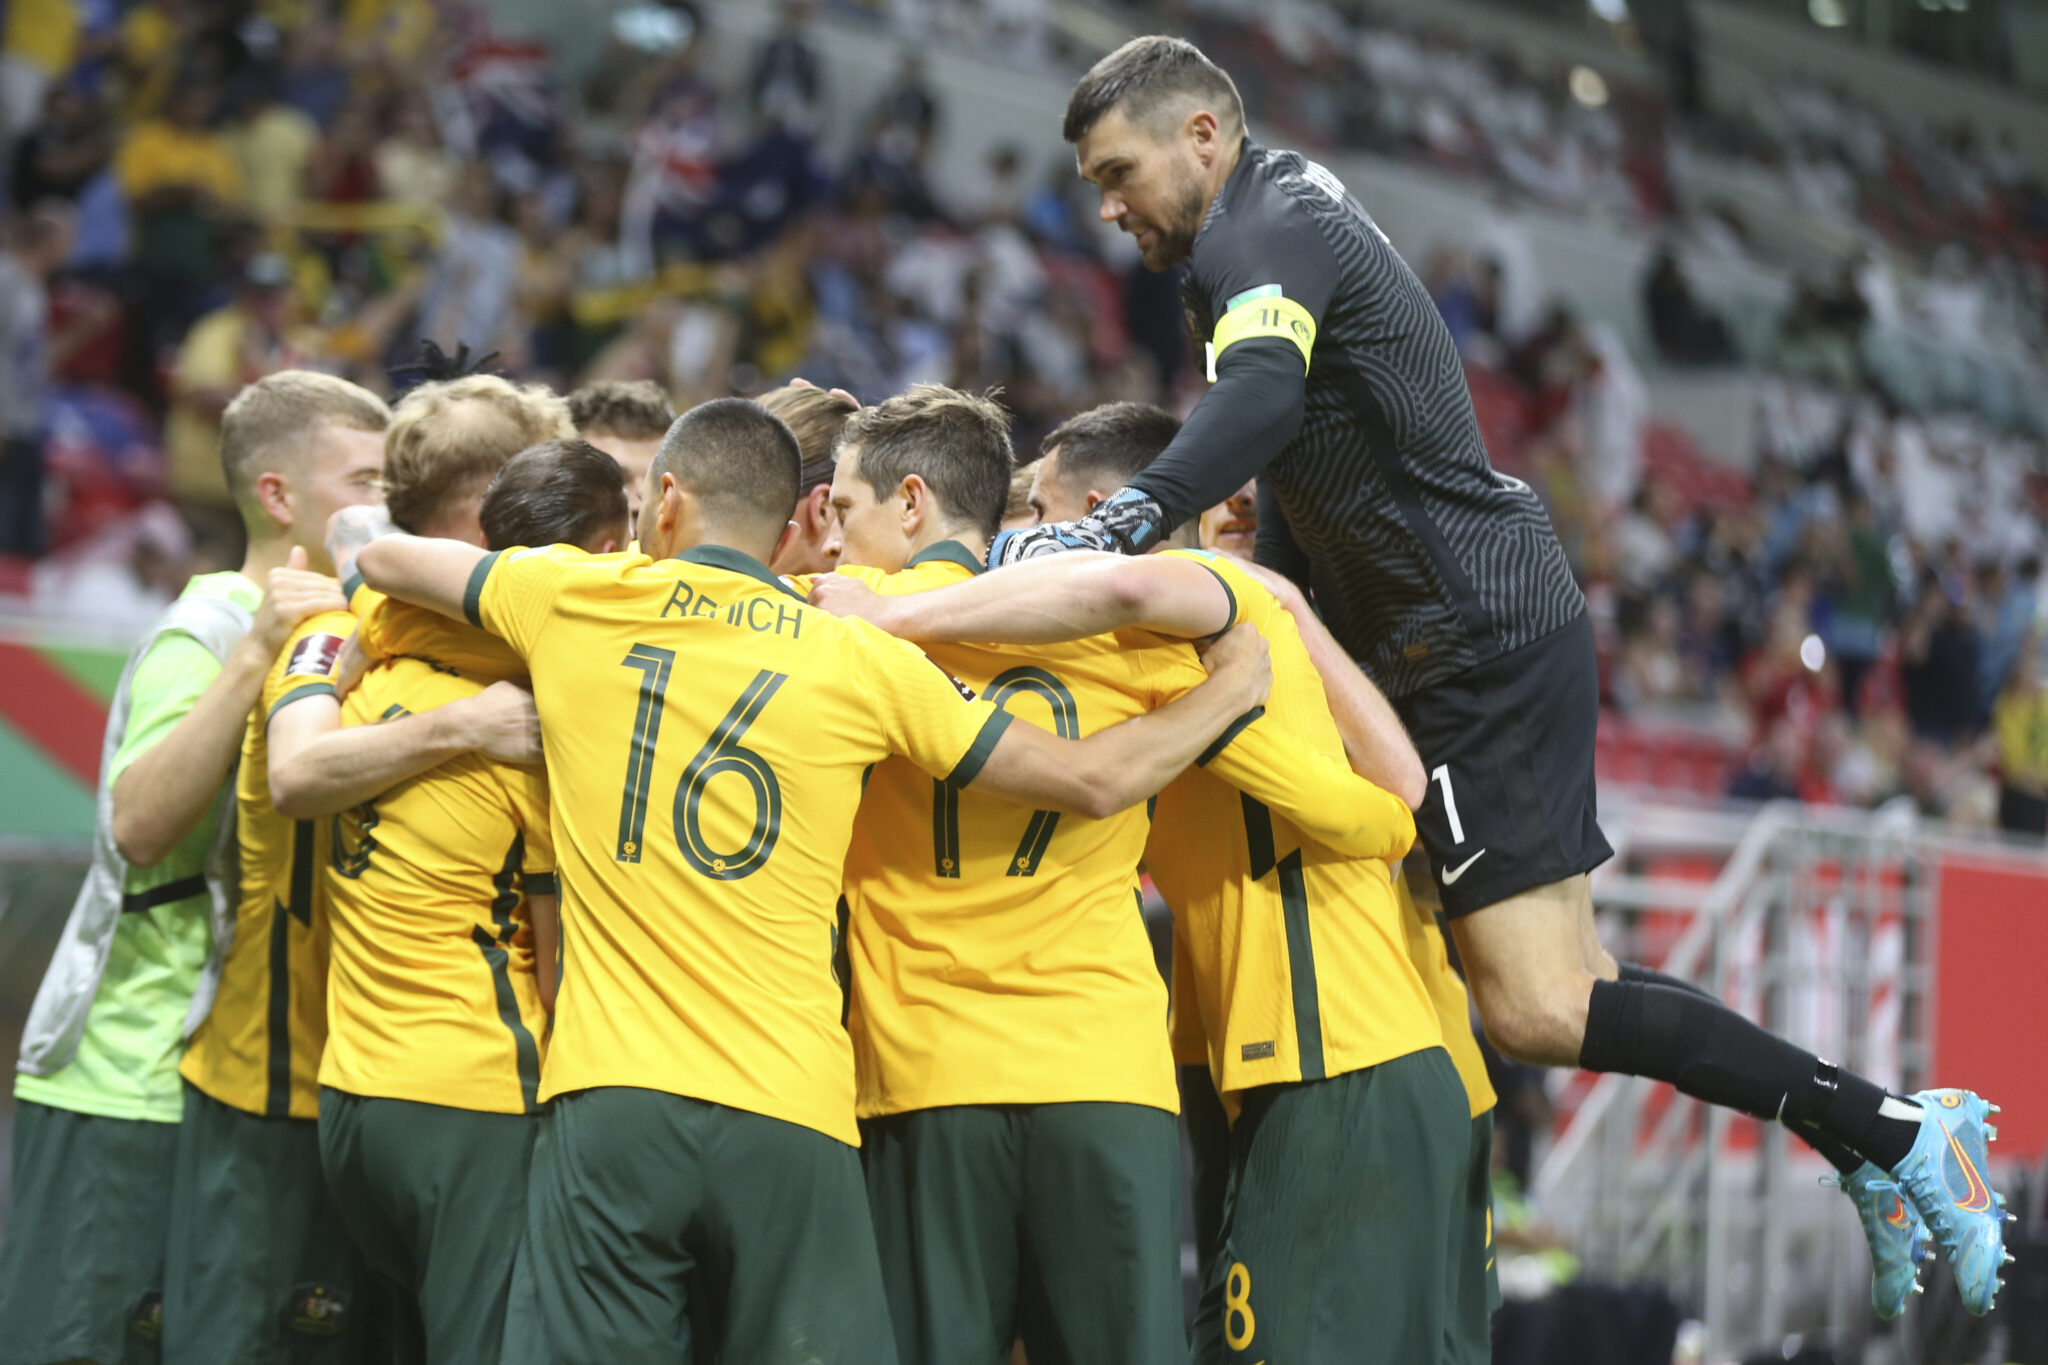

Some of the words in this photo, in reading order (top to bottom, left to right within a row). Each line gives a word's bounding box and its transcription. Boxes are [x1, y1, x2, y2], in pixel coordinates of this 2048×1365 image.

[615, 642, 789, 881] 16
[1432, 763, 1465, 845] 1
[1224, 1262, 1256, 1352] 8
